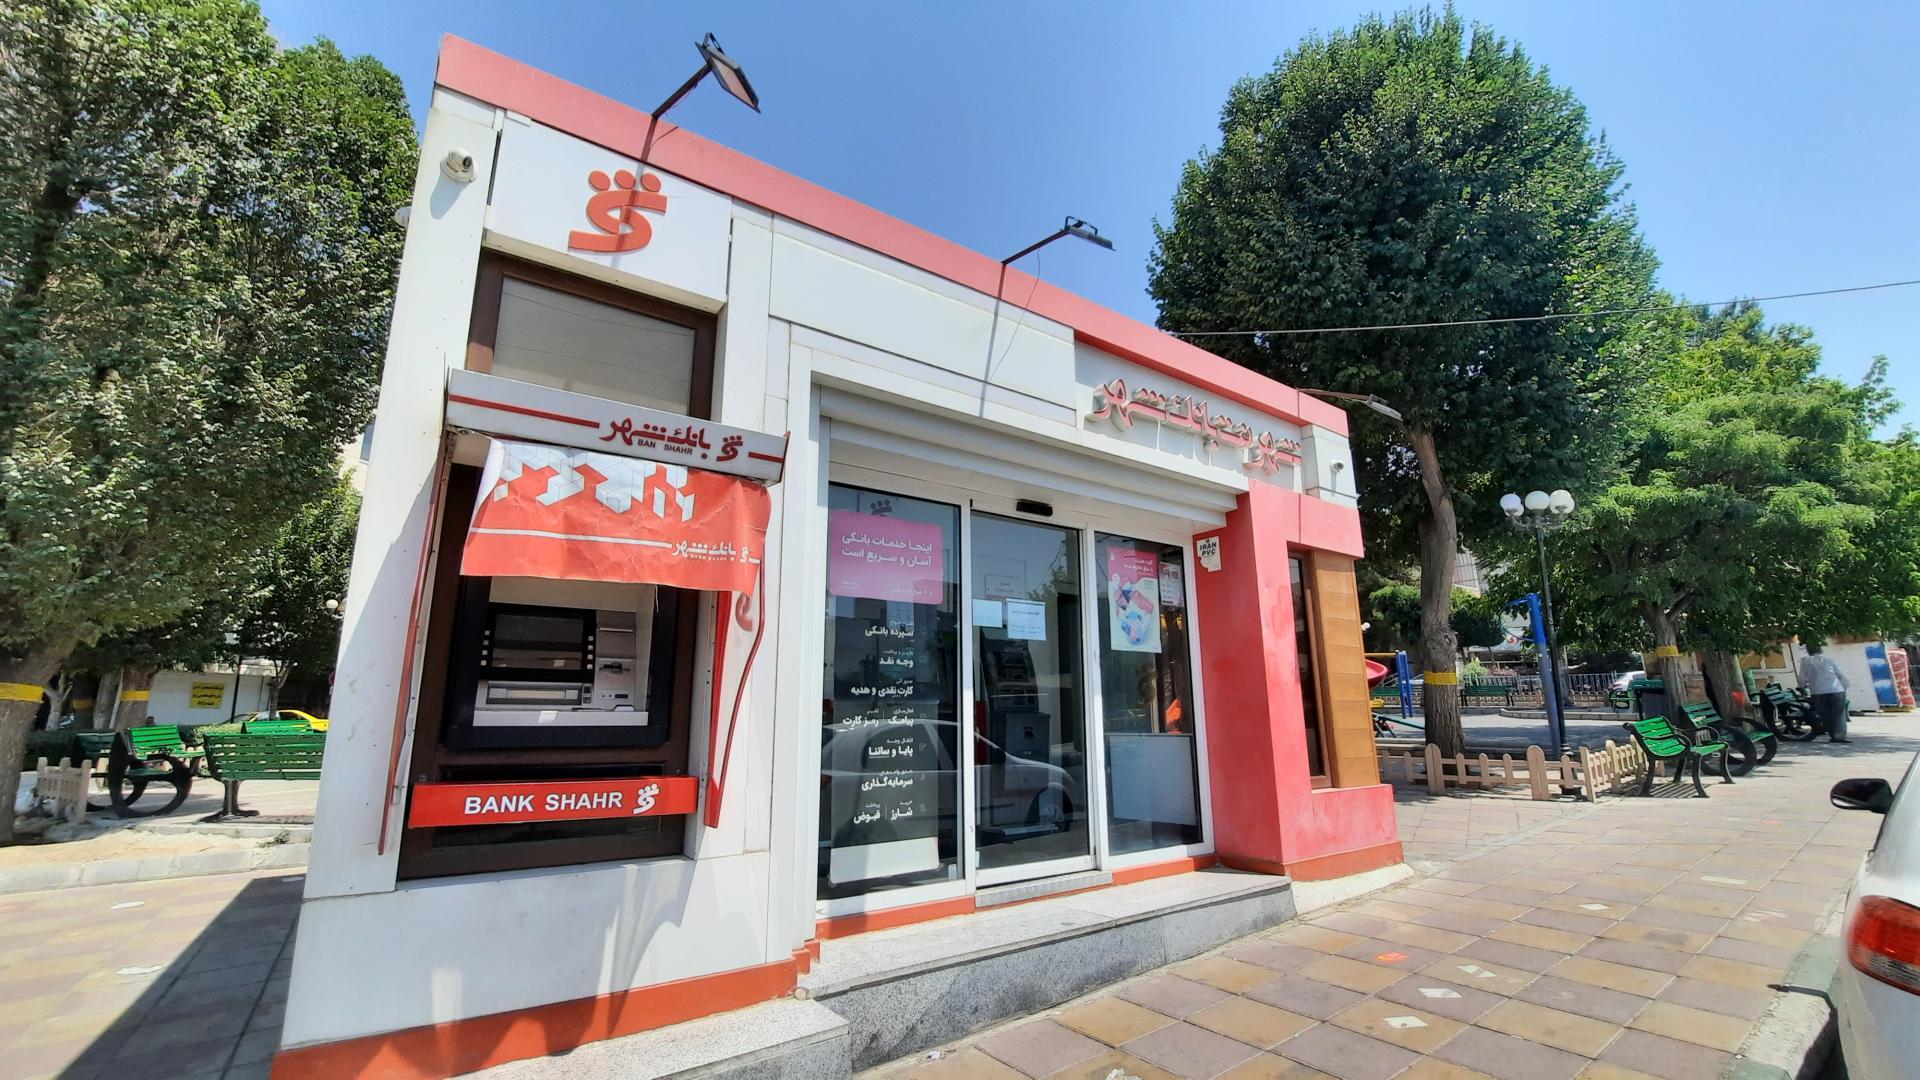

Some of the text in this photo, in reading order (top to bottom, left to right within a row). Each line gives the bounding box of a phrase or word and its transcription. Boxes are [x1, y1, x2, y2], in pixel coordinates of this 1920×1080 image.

[1085, 377, 1166, 431] شهر
[599, 417, 665, 446] شهر
[664, 443, 693, 455] SHAHR
[672, 540, 707, 558] شهر
[842, 532, 932, 554] اینجا خدمات بانکی
[1200, 541, 1217, 551] IRAN
[842, 546, 932, 568] آسان و سریع است
[1201, 548, 1216, 557] PVC
[865, 625, 914, 639] سپرده بانکی
[879, 656, 914, 668] وجه نقد
[851, 685, 914, 697] کارت نقدی و هدیه
[843, 715, 879, 728] رمز کارت
[888, 715, 914, 727] پیامک
[868, 746, 914, 757] پایا و ساتنا
[464, 791, 623, 815] BANK SHAHR
[853, 809, 881, 824] قبوض
[890, 806, 913, 821] شارژ
